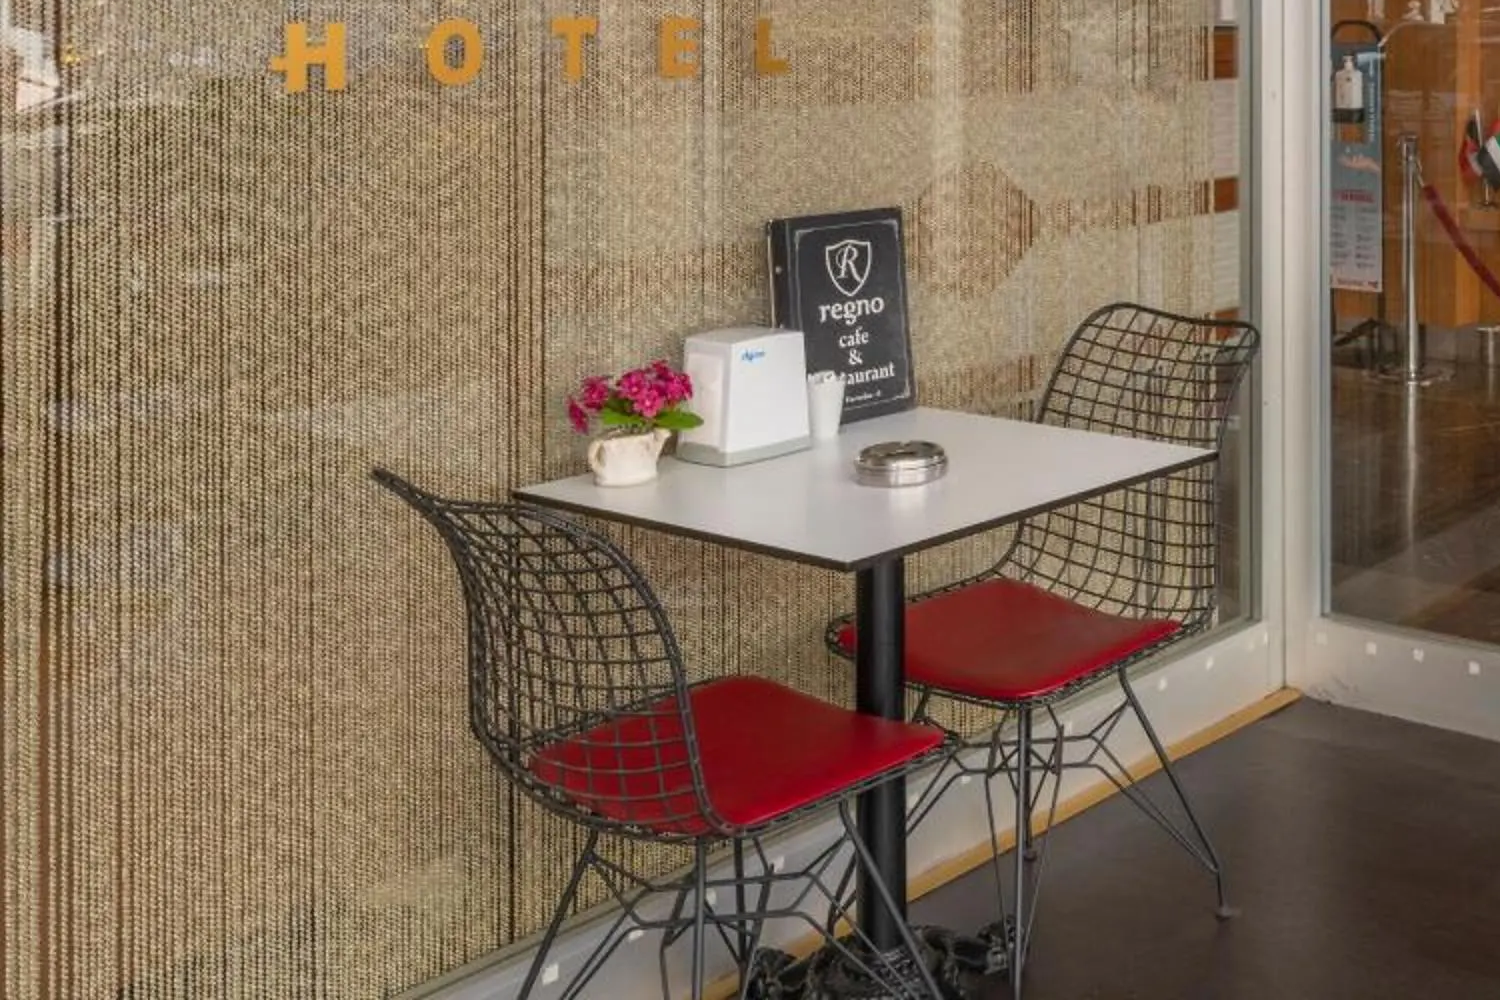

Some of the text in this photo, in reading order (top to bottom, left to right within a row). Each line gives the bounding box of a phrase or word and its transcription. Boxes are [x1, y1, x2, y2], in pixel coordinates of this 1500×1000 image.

[282, 16, 789, 94] HOTEL
[818, 297, 885, 325] regno
[838, 326, 870, 348] cafe
[848, 348, 864, 365] &
